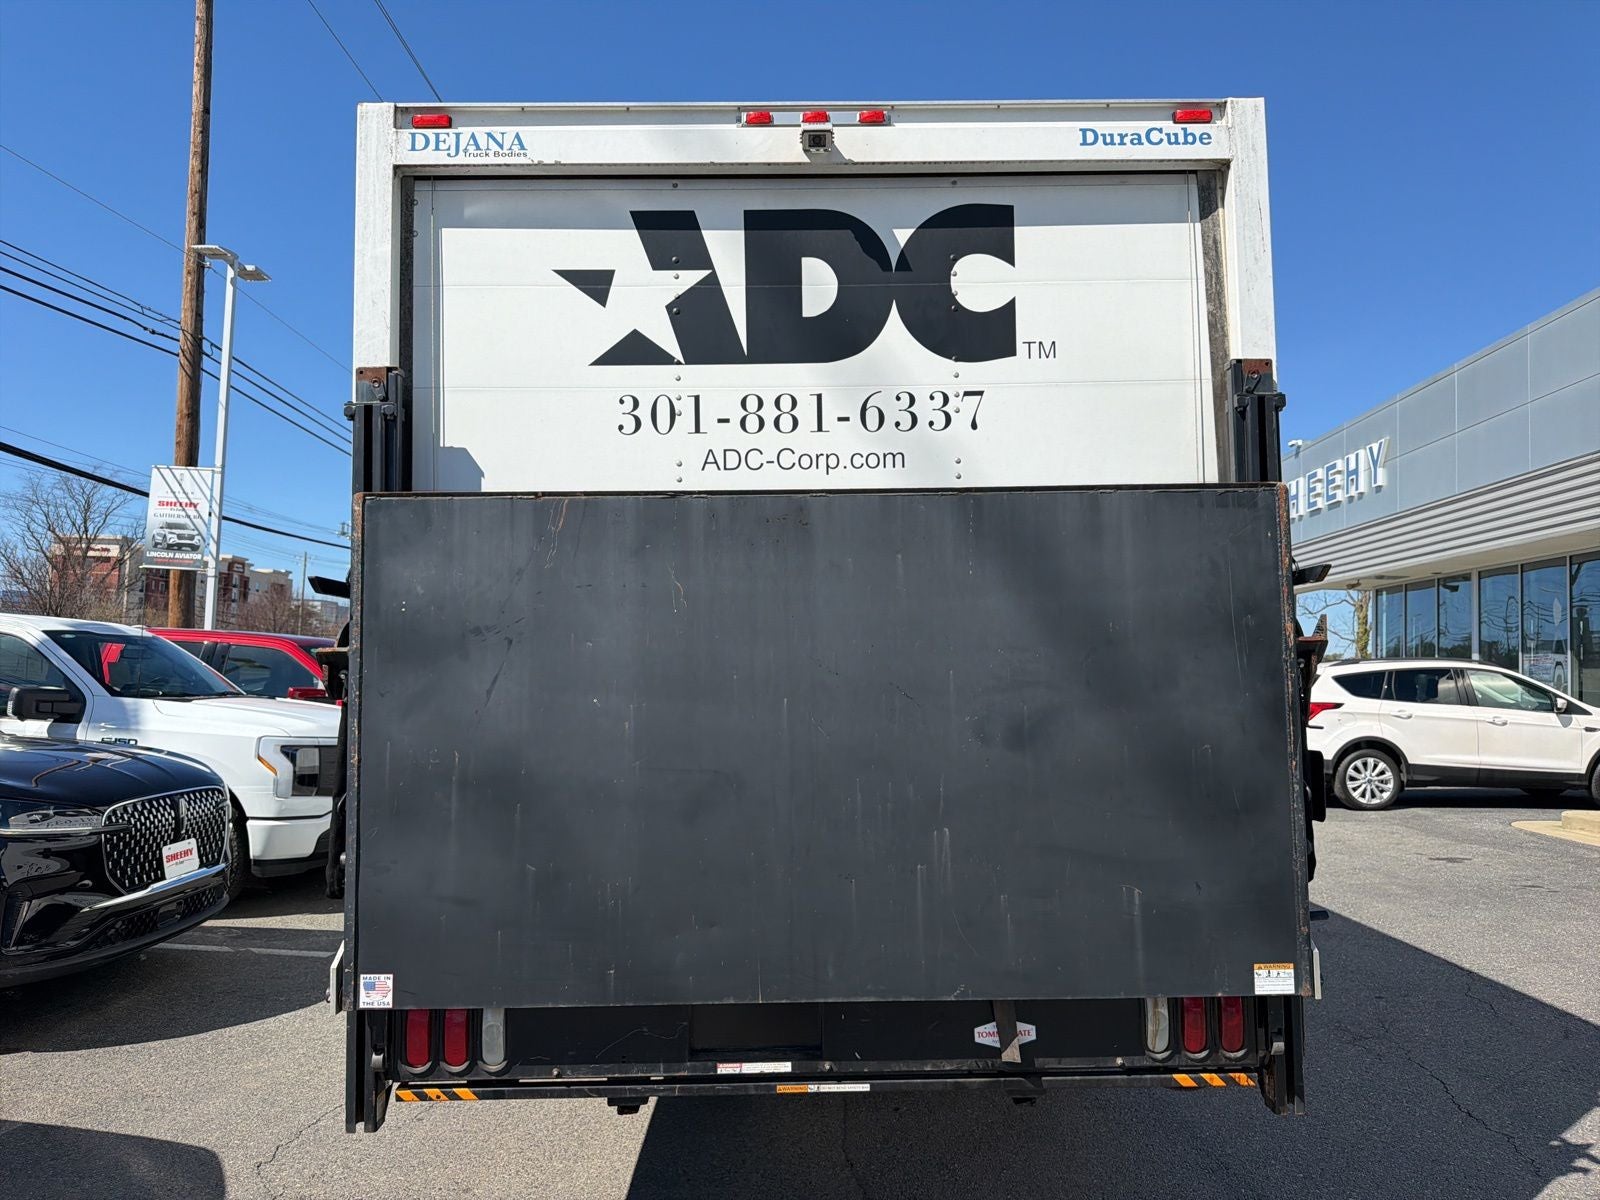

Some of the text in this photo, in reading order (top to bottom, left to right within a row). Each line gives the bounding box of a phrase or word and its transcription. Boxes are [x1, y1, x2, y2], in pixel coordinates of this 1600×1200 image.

[408, 131, 527, 158] DEJANA
[1079, 127, 1212, 146] DuraCube
[463, 150, 528, 158] Truck Bodies
[552, 203, 1057, 366] ADC TM
[617, 390, 986, 436] 301-881-6337
[701, 447, 906, 476] ADC-Corp.com
[1289, 436, 1390, 518] HEEHY
[146, 551, 202, 560] LINCOLN AVIATOR
[165, 848, 193, 863] SHEEHY
